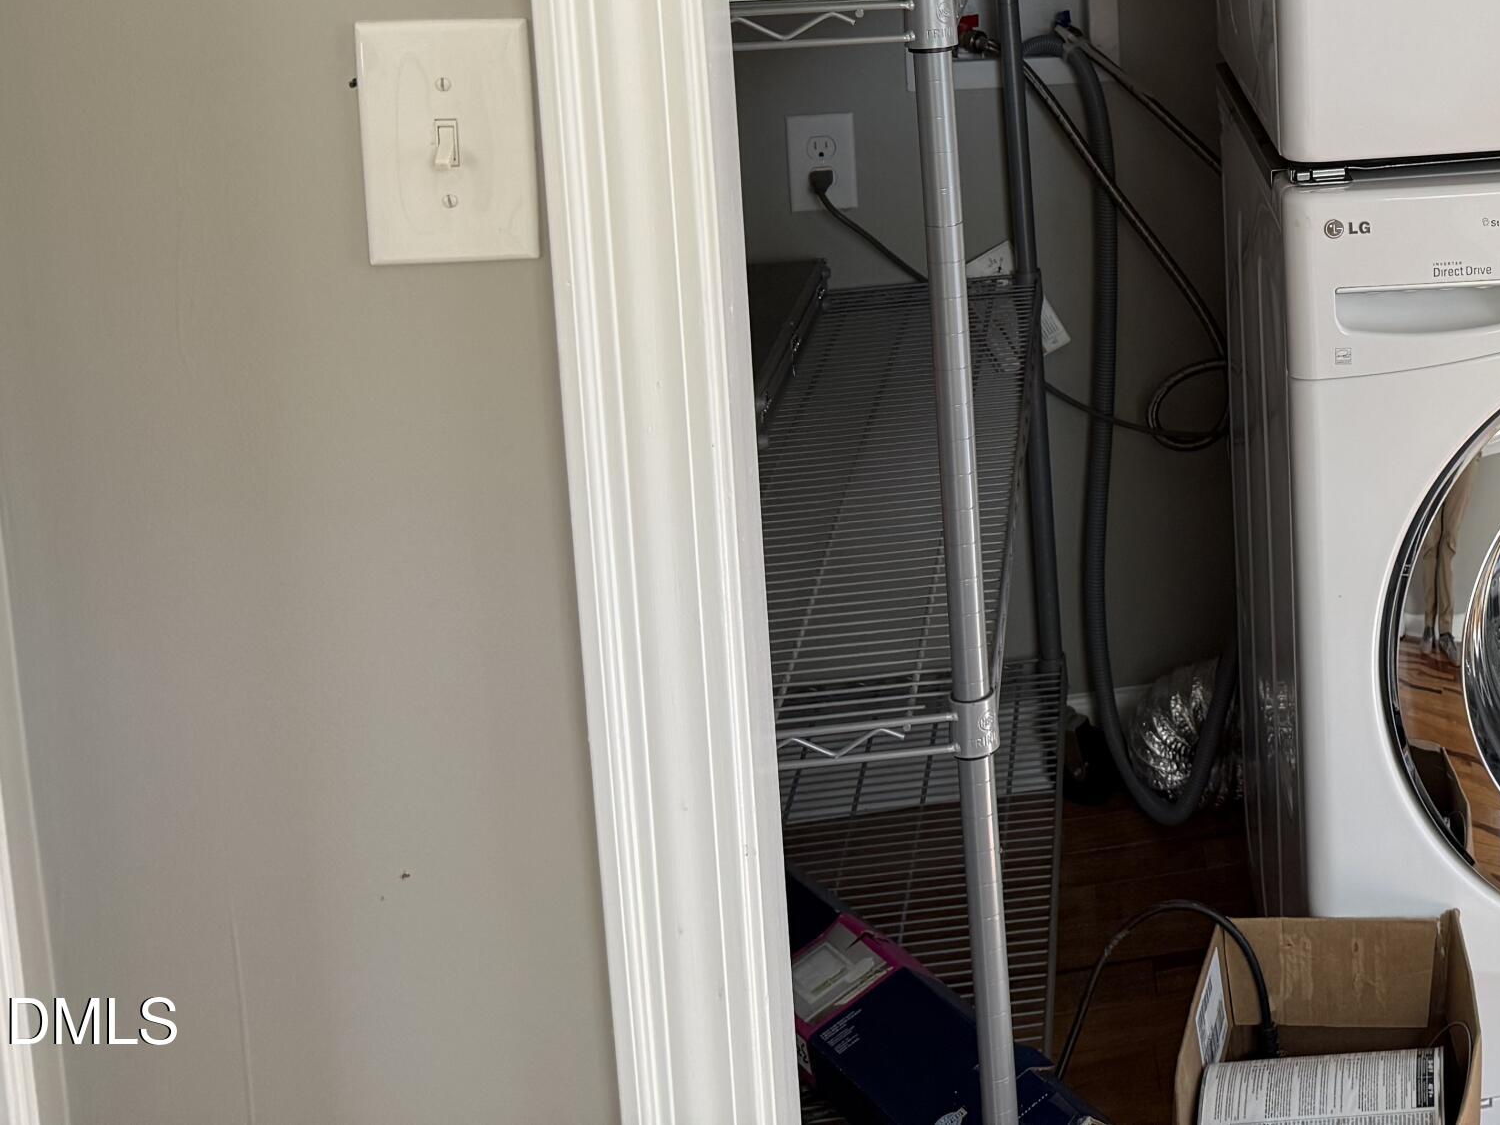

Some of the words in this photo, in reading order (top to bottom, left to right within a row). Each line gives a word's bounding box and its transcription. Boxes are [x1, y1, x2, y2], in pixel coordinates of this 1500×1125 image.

[1348, 221, 1371, 235] LG
[1433, 267, 1464, 278] Direct
[1466, 266, 1492, 276] Drive
